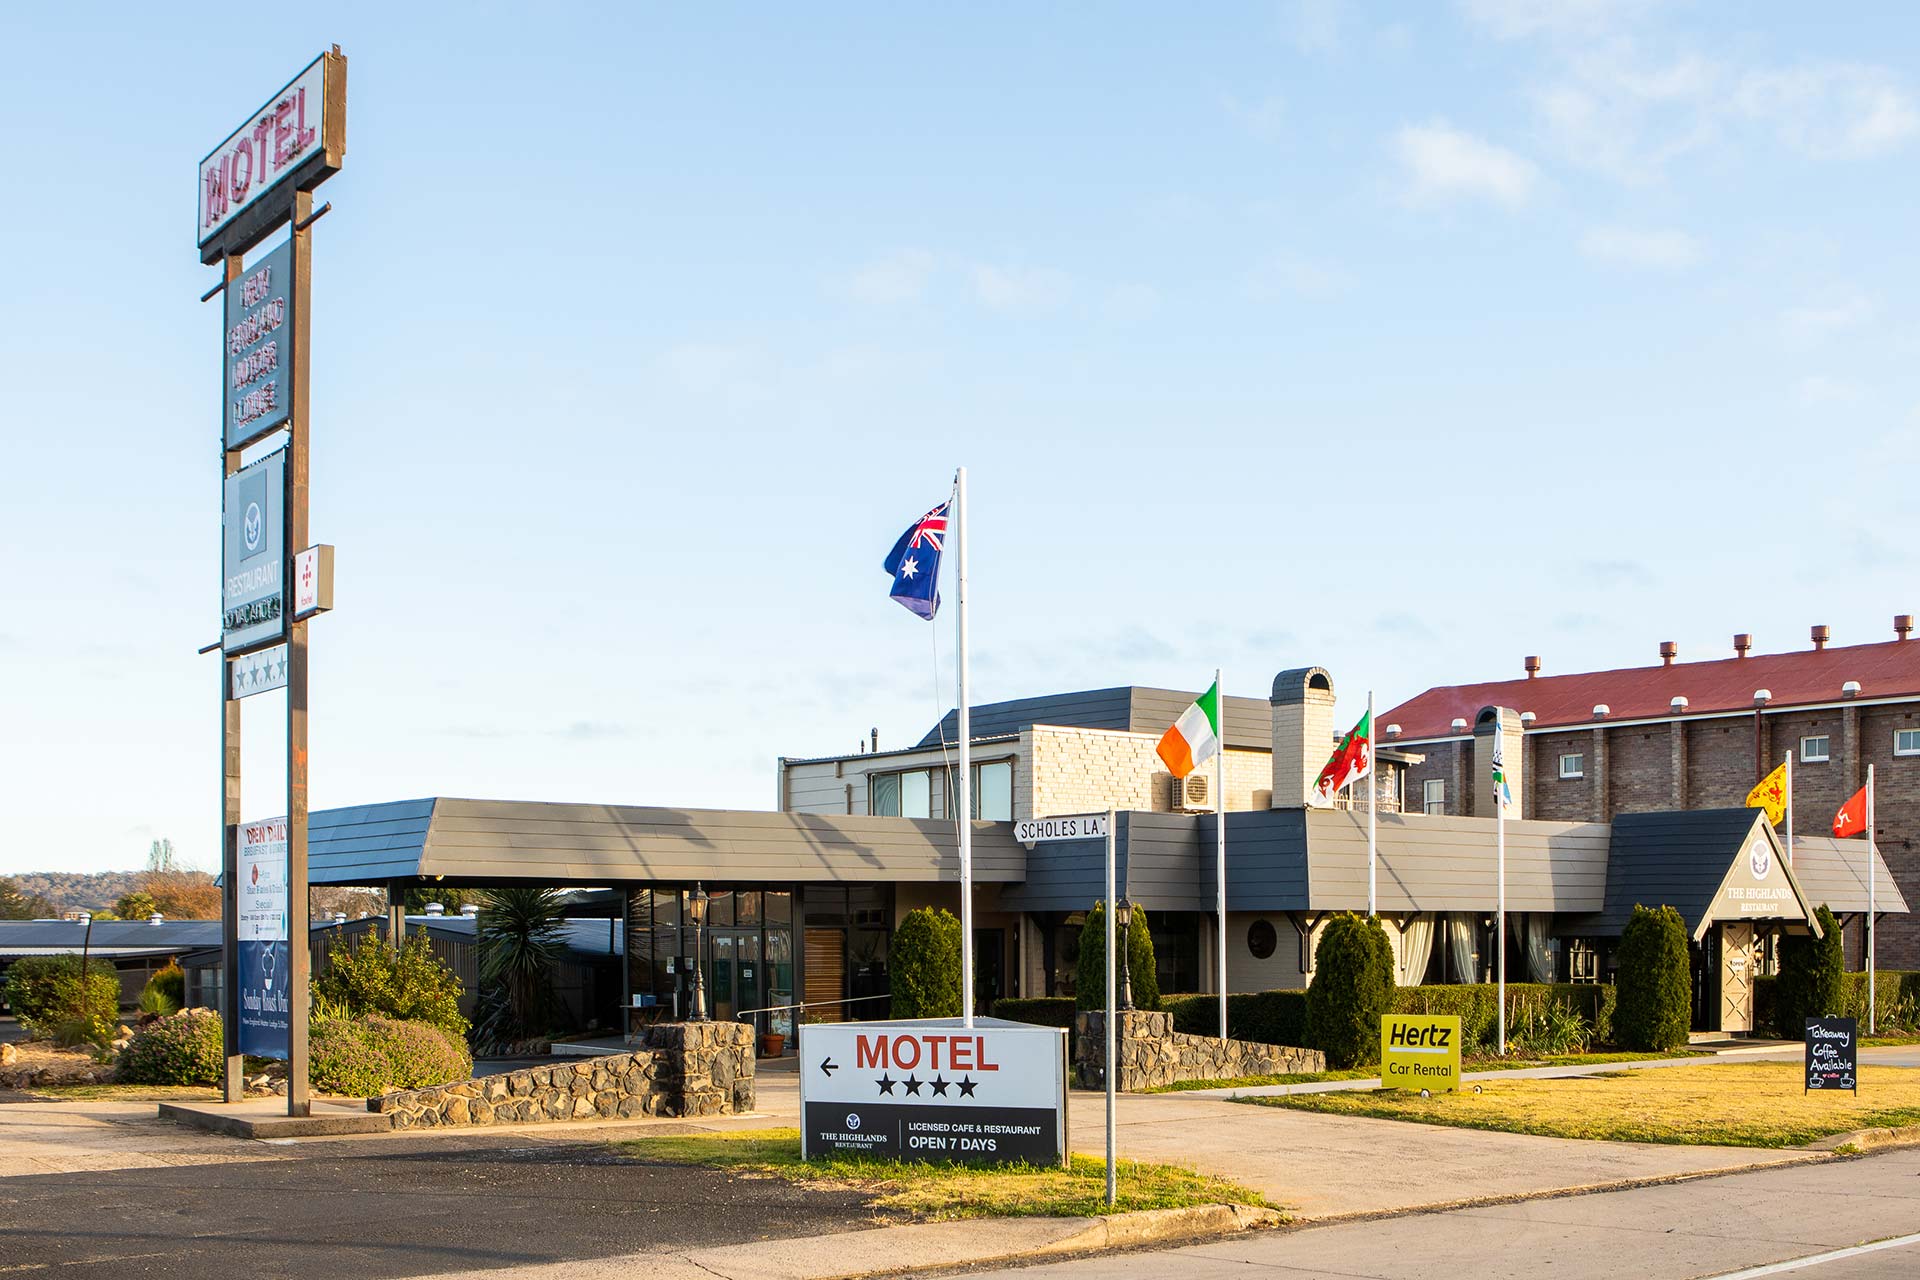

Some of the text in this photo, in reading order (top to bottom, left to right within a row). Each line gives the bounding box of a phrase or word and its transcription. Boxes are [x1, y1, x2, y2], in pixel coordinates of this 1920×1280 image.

[205, 86, 315, 228] MOTEL
[227, 561, 279, 598] RESTAURANT
[246, 826, 265, 845] OPEN
[1021, 819, 1099, 839] SCHOLES LA
[1728, 888, 1792, 899] THE HIGHLANDS
[1741, 903, 1778, 912] RESTAURANT
[1390, 1023, 1452, 1047] Hertz
[1807, 1024, 1850, 1047] Takeaway
[856, 1035, 999, 1071] MOTEL
[1812, 1043, 1839, 1060] Coffee
[1389, 1062, 1451, 1076] Car Rental
[1810, 1058, 1852, 1071] Available
[908, 1122, 1041, 1135] LICENSED CAFE & RESTAURANT
[820, 1132, 887, 1143] THE HIGHLANDS
[909, 1136, 997, 1152] OPEN 7 DAYS
